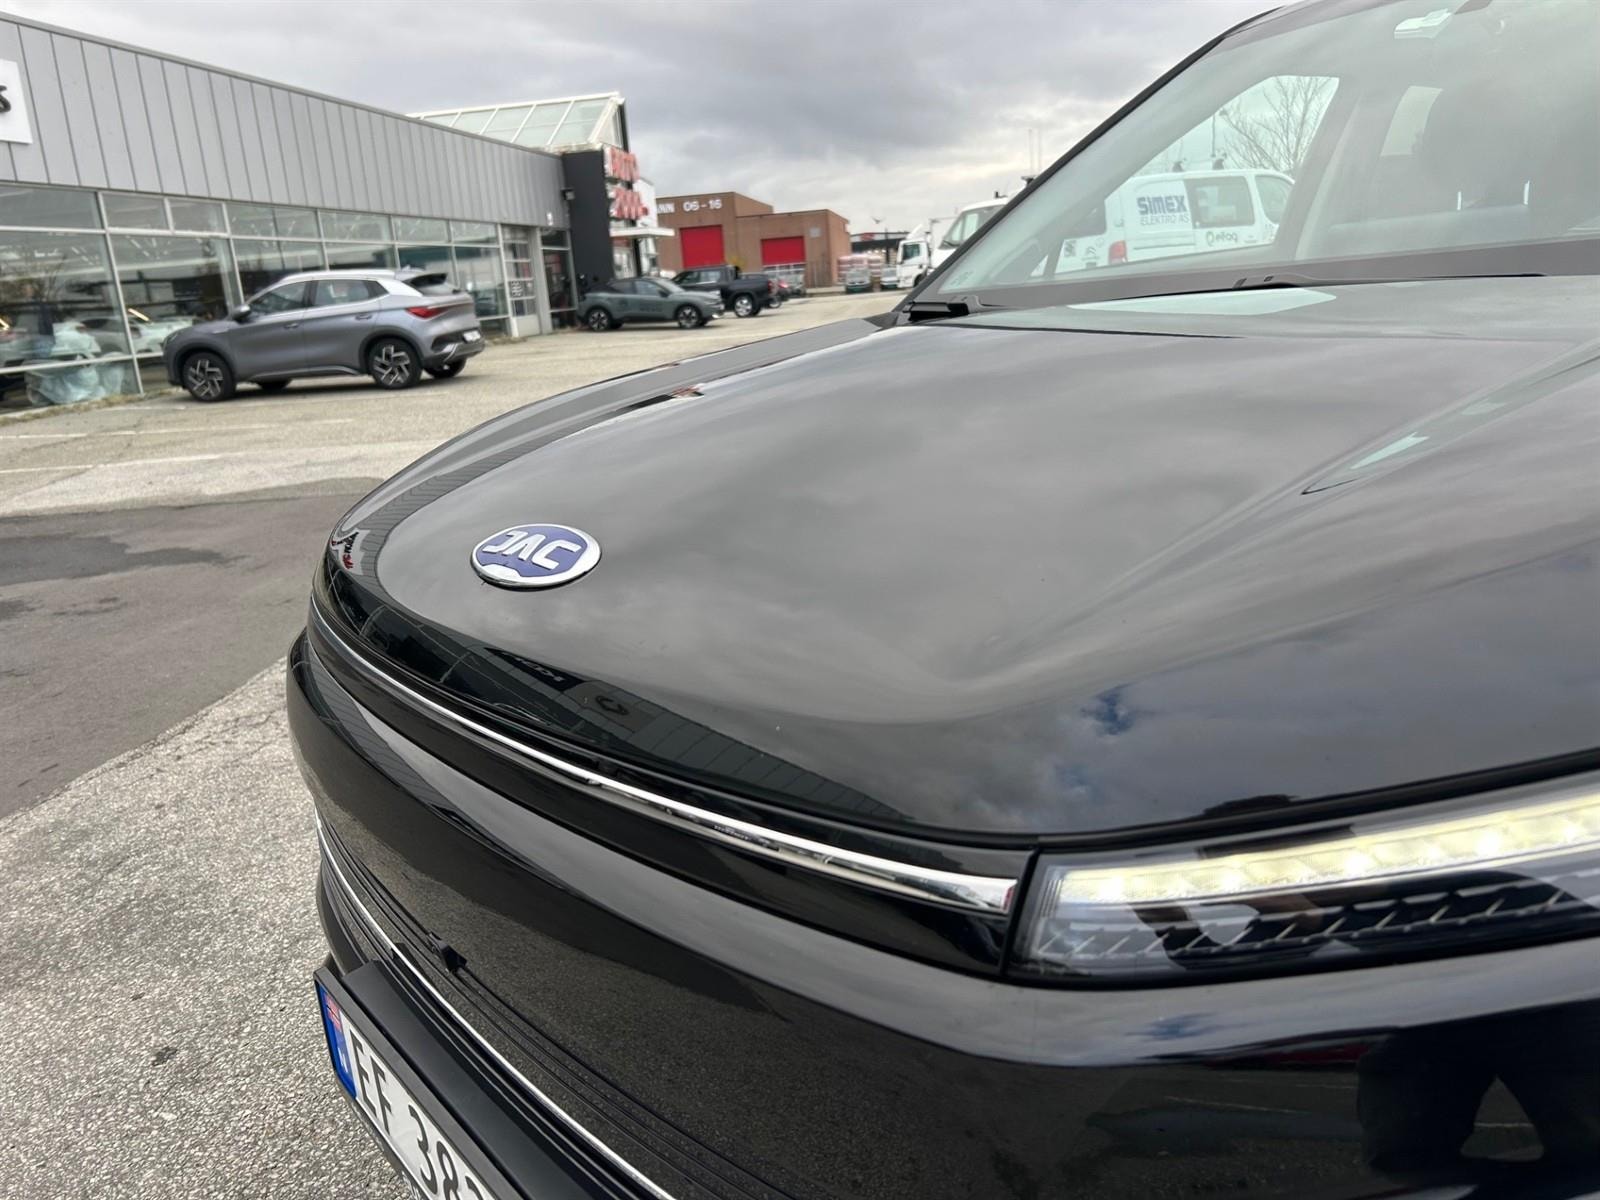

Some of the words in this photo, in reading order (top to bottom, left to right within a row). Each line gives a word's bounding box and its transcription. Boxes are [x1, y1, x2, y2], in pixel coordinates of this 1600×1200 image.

[1137, 195, 1187, 215] SIMEX
[483, 531, 581, 570] JAC
[350, 1030, 392, 1136] EF
[408, 1104, 483, 1200] 38
